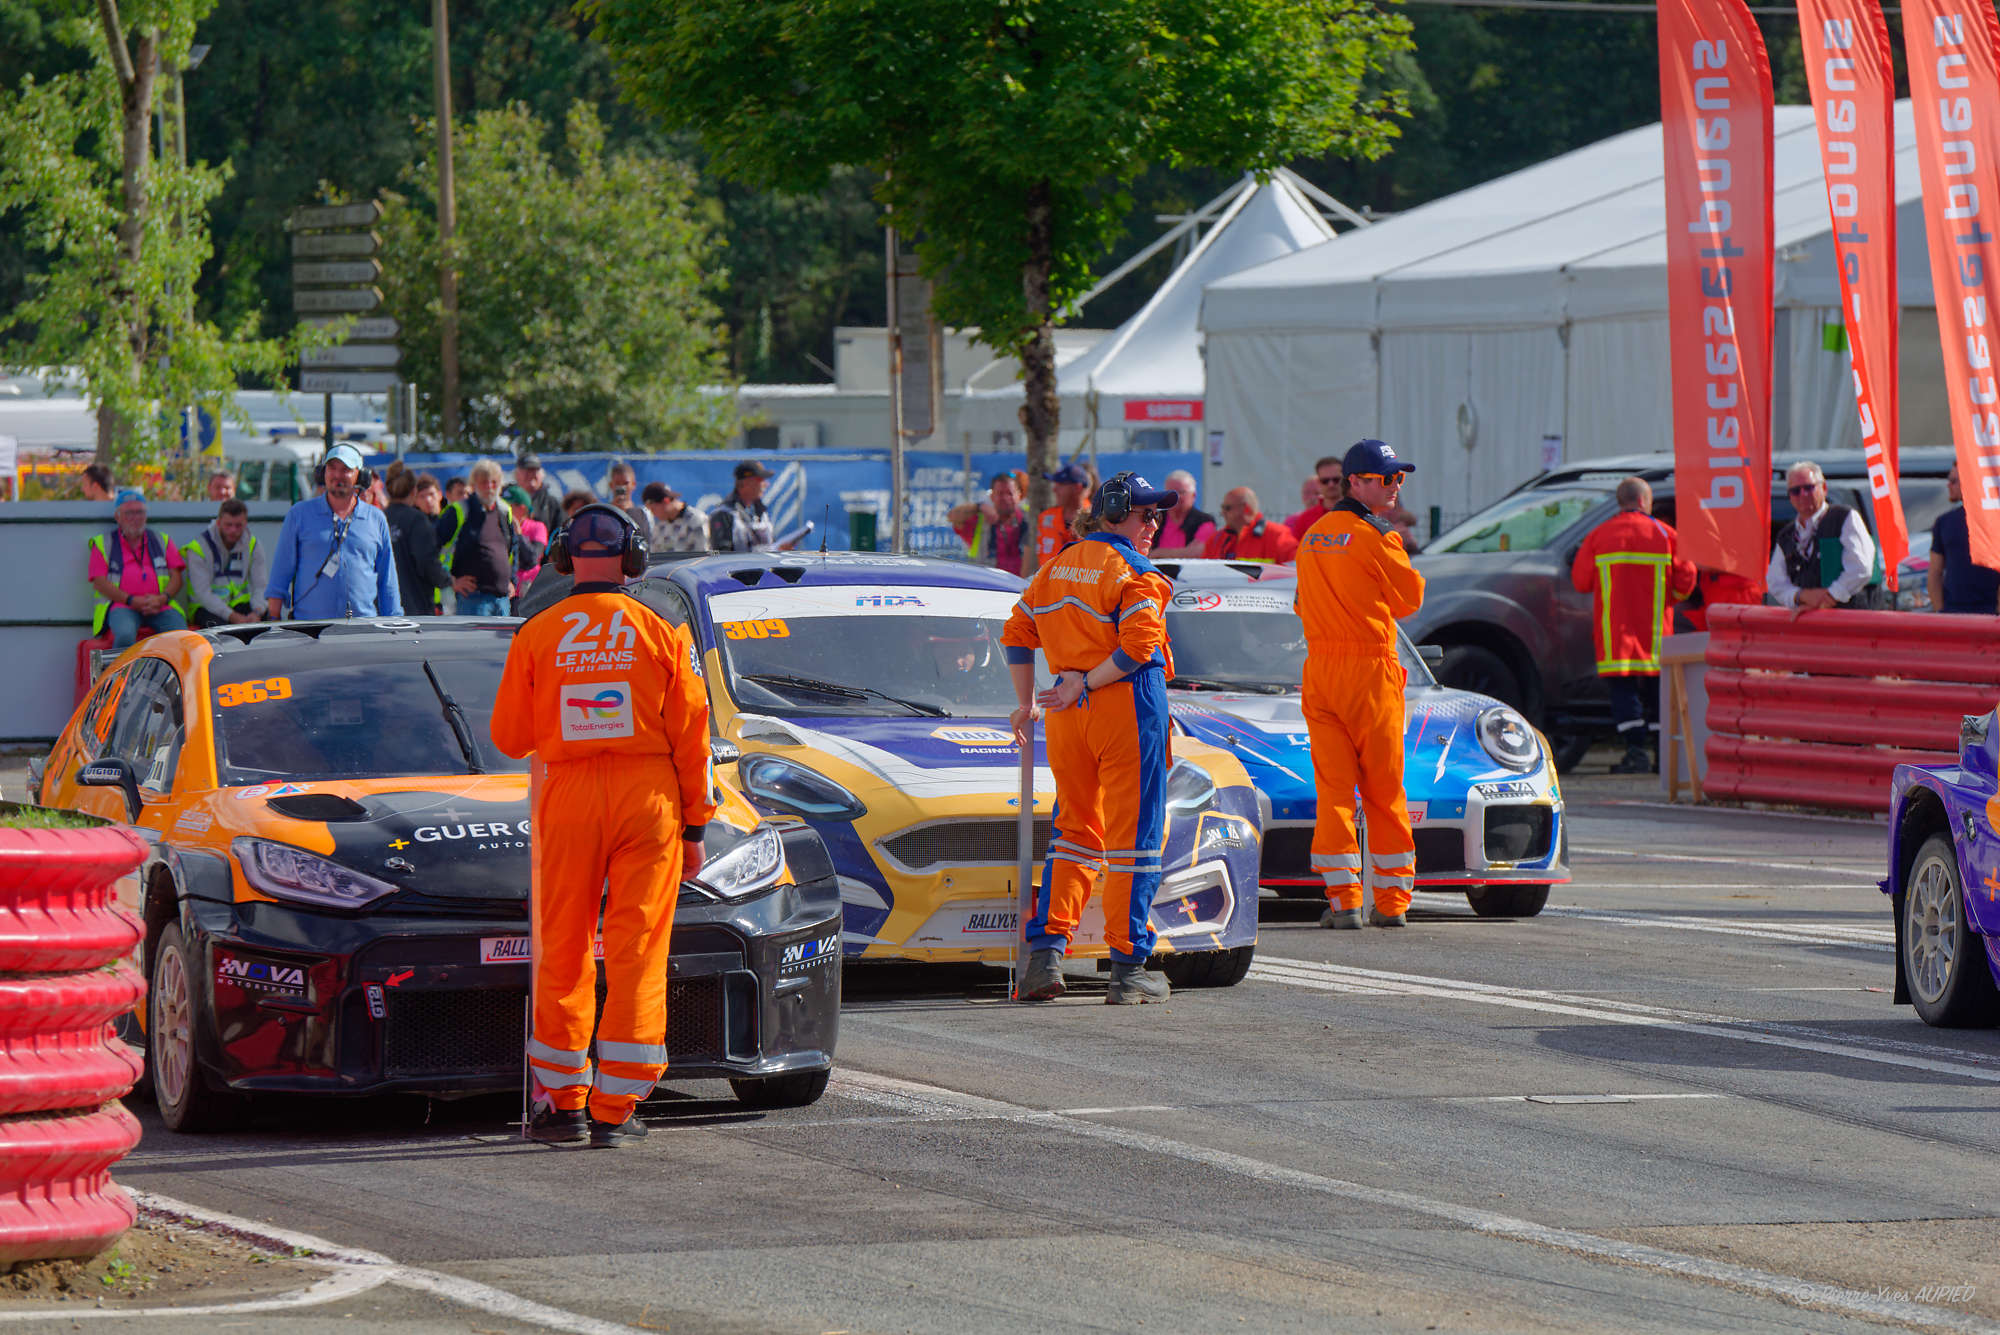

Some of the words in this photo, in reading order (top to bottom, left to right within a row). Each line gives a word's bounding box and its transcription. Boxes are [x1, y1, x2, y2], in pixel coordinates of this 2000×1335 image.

[1301, 533, 1346, 548] FFSA
[556, 609, 637, 653] 24h
[722, 618, 791, 640] 309
[555, 653, 578, 667] LE
[579, 650, 634, 665] MANS
[217, 676, 293, 708] 369
[570, 721, 625, 732] TotalEnergies
[942, 731, 1010, 741] NAPA
[413, 822, 513, 843] GUER
[478, 841, 531, 850] AUTO
[217, 978, 305, 996] MOTORSPORT
